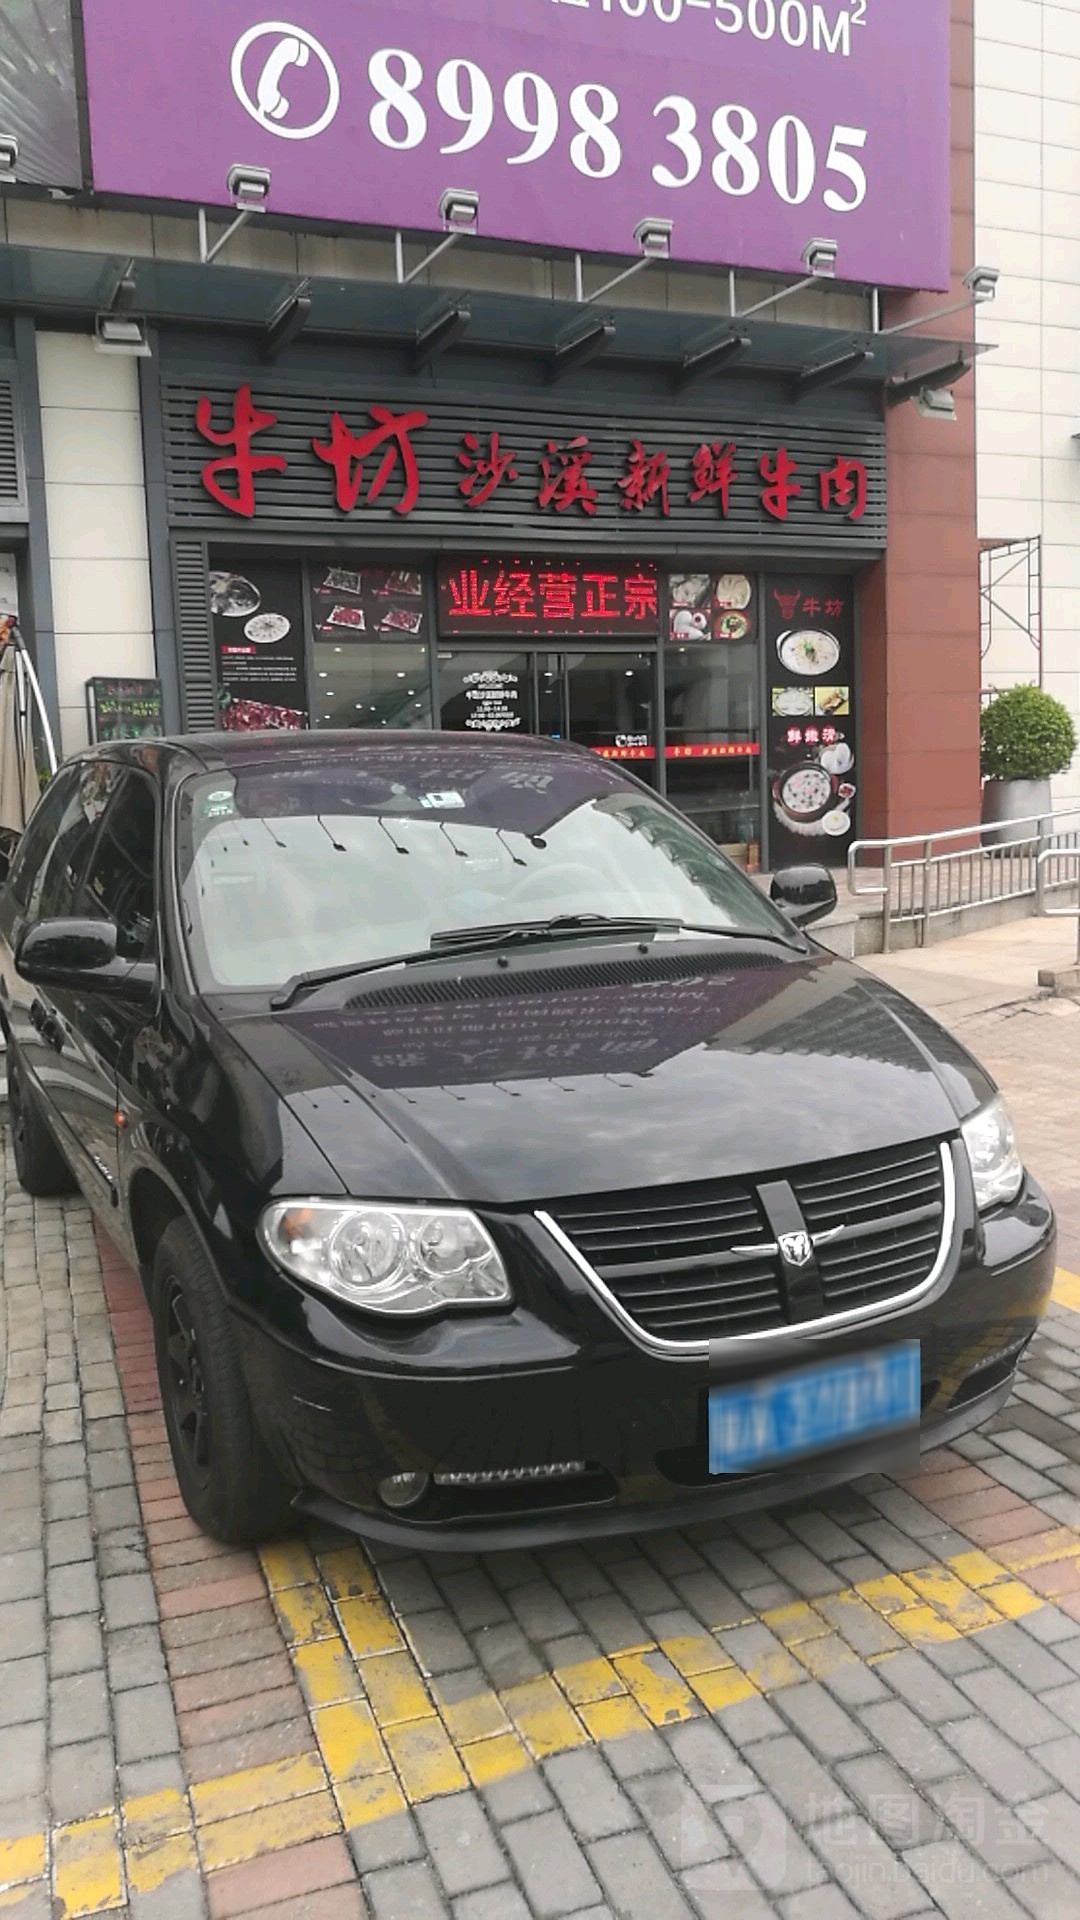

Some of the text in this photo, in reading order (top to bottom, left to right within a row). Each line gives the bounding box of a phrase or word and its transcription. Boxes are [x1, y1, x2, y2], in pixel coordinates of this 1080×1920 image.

[367, 46, 869, 213] 8998 3805
[195, 384, 868, 522] 牛坊 沙溪新鲜牛肉
[448, 569, 658, 620] 业经营正宗
